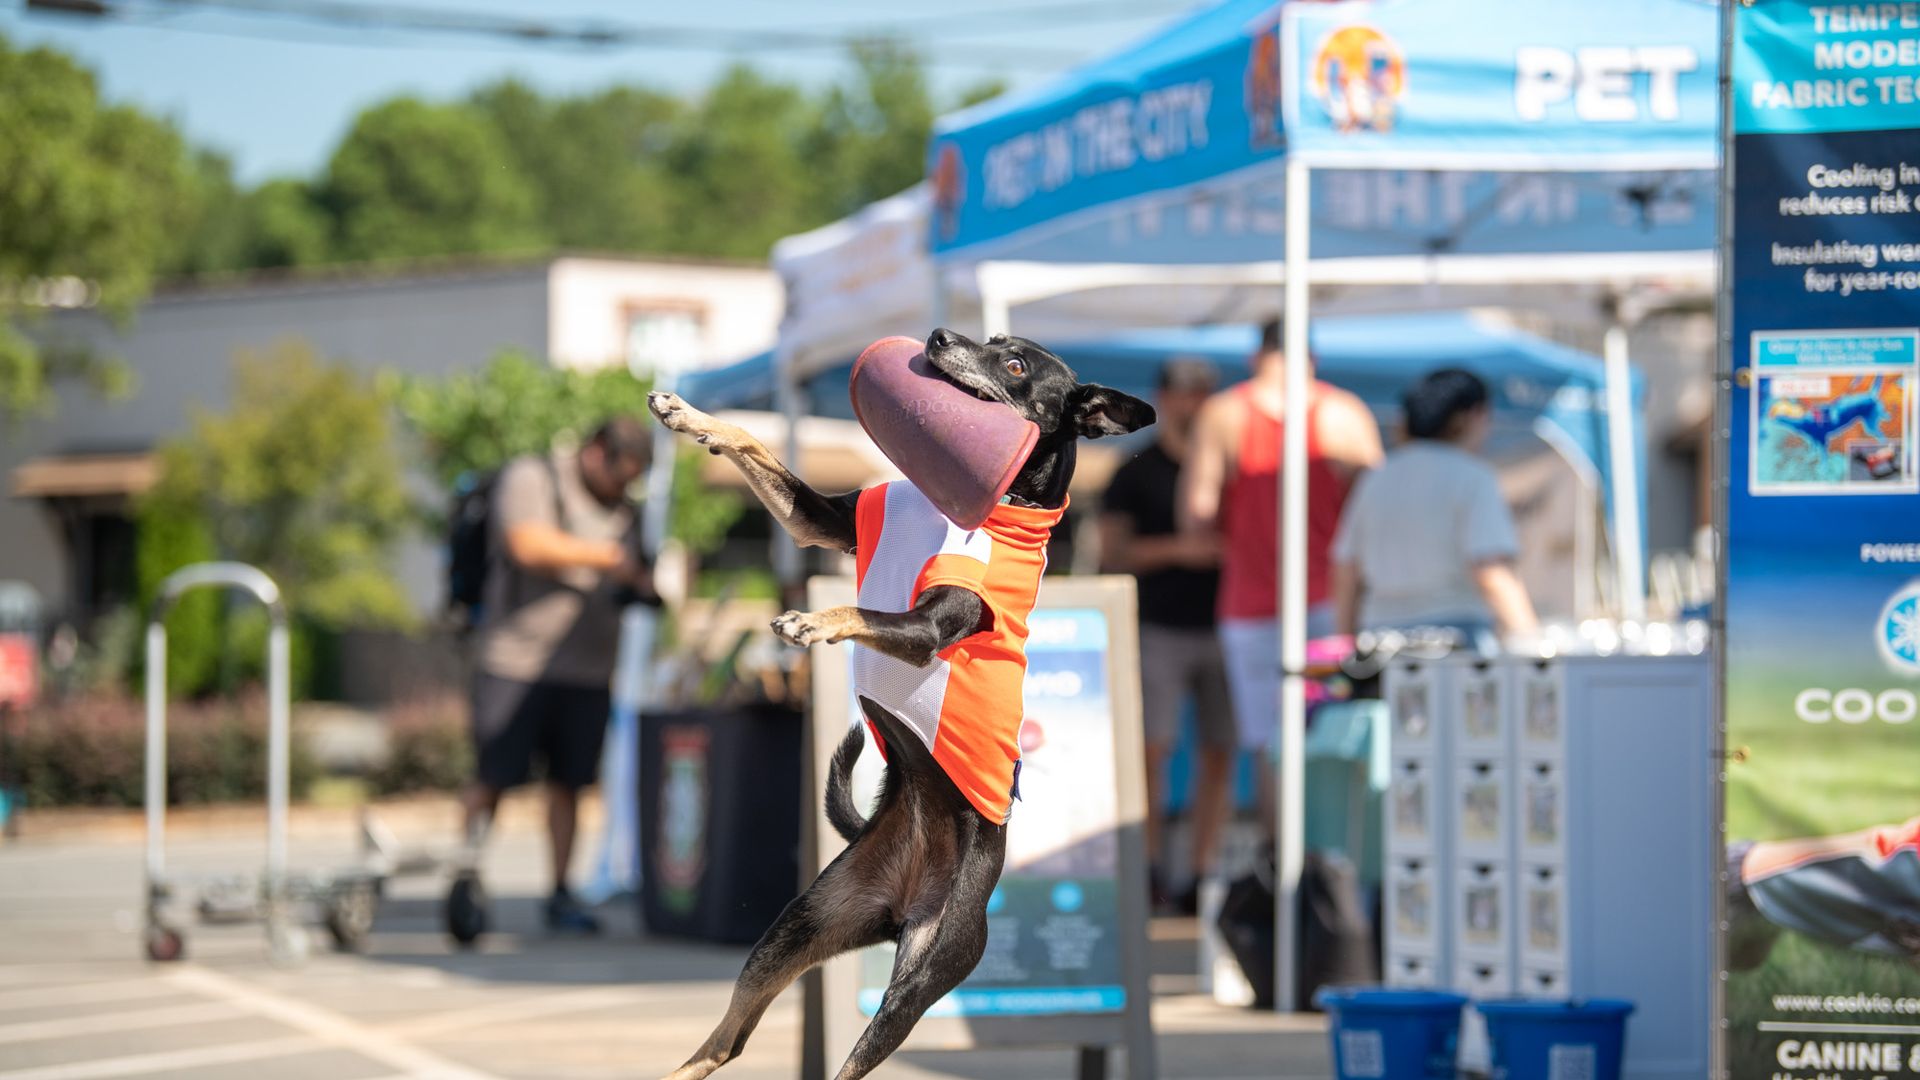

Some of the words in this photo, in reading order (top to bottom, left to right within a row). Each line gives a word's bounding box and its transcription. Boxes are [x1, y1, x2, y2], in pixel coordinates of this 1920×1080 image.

[1814, 39, 1920, 69] MODE
[1515, 45, 1698, 122] PET
[1752, 77, 1868, 109] FABRIC
[1874, 75, 1920, 104] TE
[1072, 97, 1137, 177] THE
[1135, 78, 1213, 161] CITY
[1807, 162, 1895, 191] Cooling
[1779, 191, 1868, 216] reduces
[1870, 189, 1911, 214] risk
[1771, 240, 1878, 268] Insulating
[1803, 267, 1838, 293] for
[1838, 271, 1920, 297] year-ro
[1860, 543, 1920, 563] POWE
[1794, 687, 1918, 725] COO
[1772, 991, 1920, 1014] www.coolvio.co
[1776, 1039, 1902, 1072] CANINE
